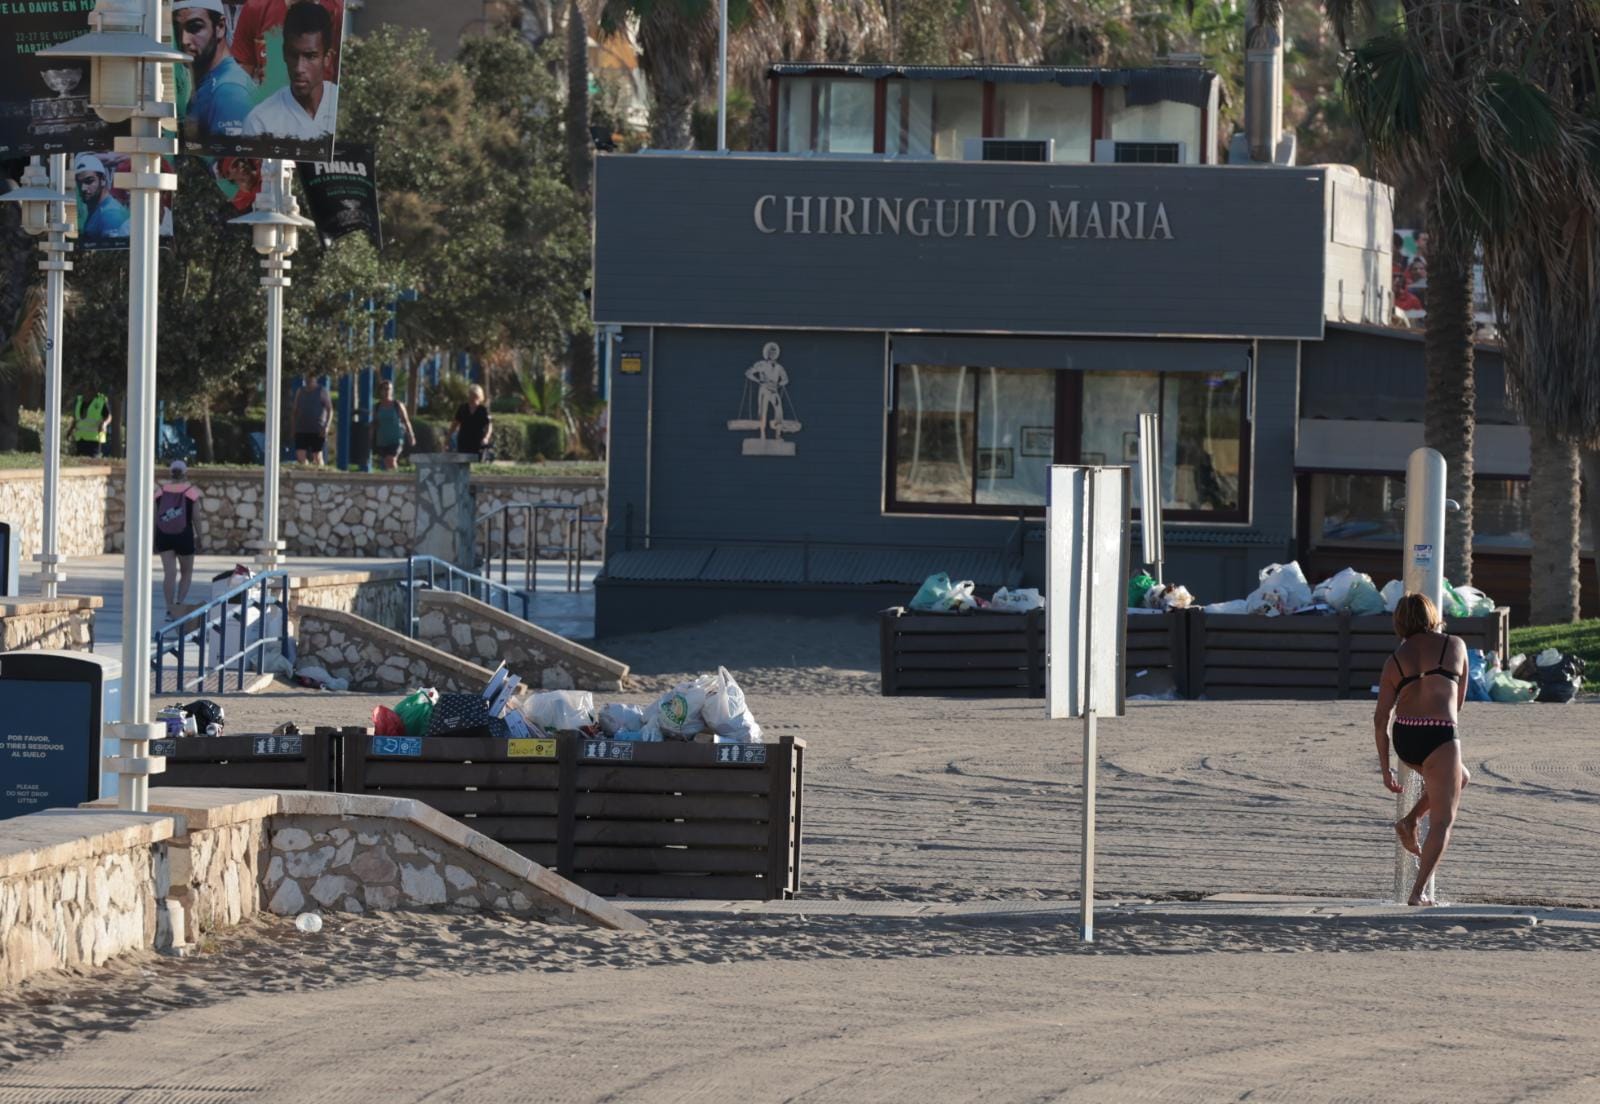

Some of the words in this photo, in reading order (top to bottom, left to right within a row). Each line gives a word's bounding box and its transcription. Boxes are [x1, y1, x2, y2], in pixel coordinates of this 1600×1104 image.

[12, 2, 25, 14] LA
[29, 1, 59, 13] DAVIS
[62, 0, 77, 12] EN
[40, 32, 50, 41] DE
[314, 161, 367, 177] FINALS
[753, 194, 1037, 239] CHIRINGUITO
[1047, 200, 1175, 240] MARIA
